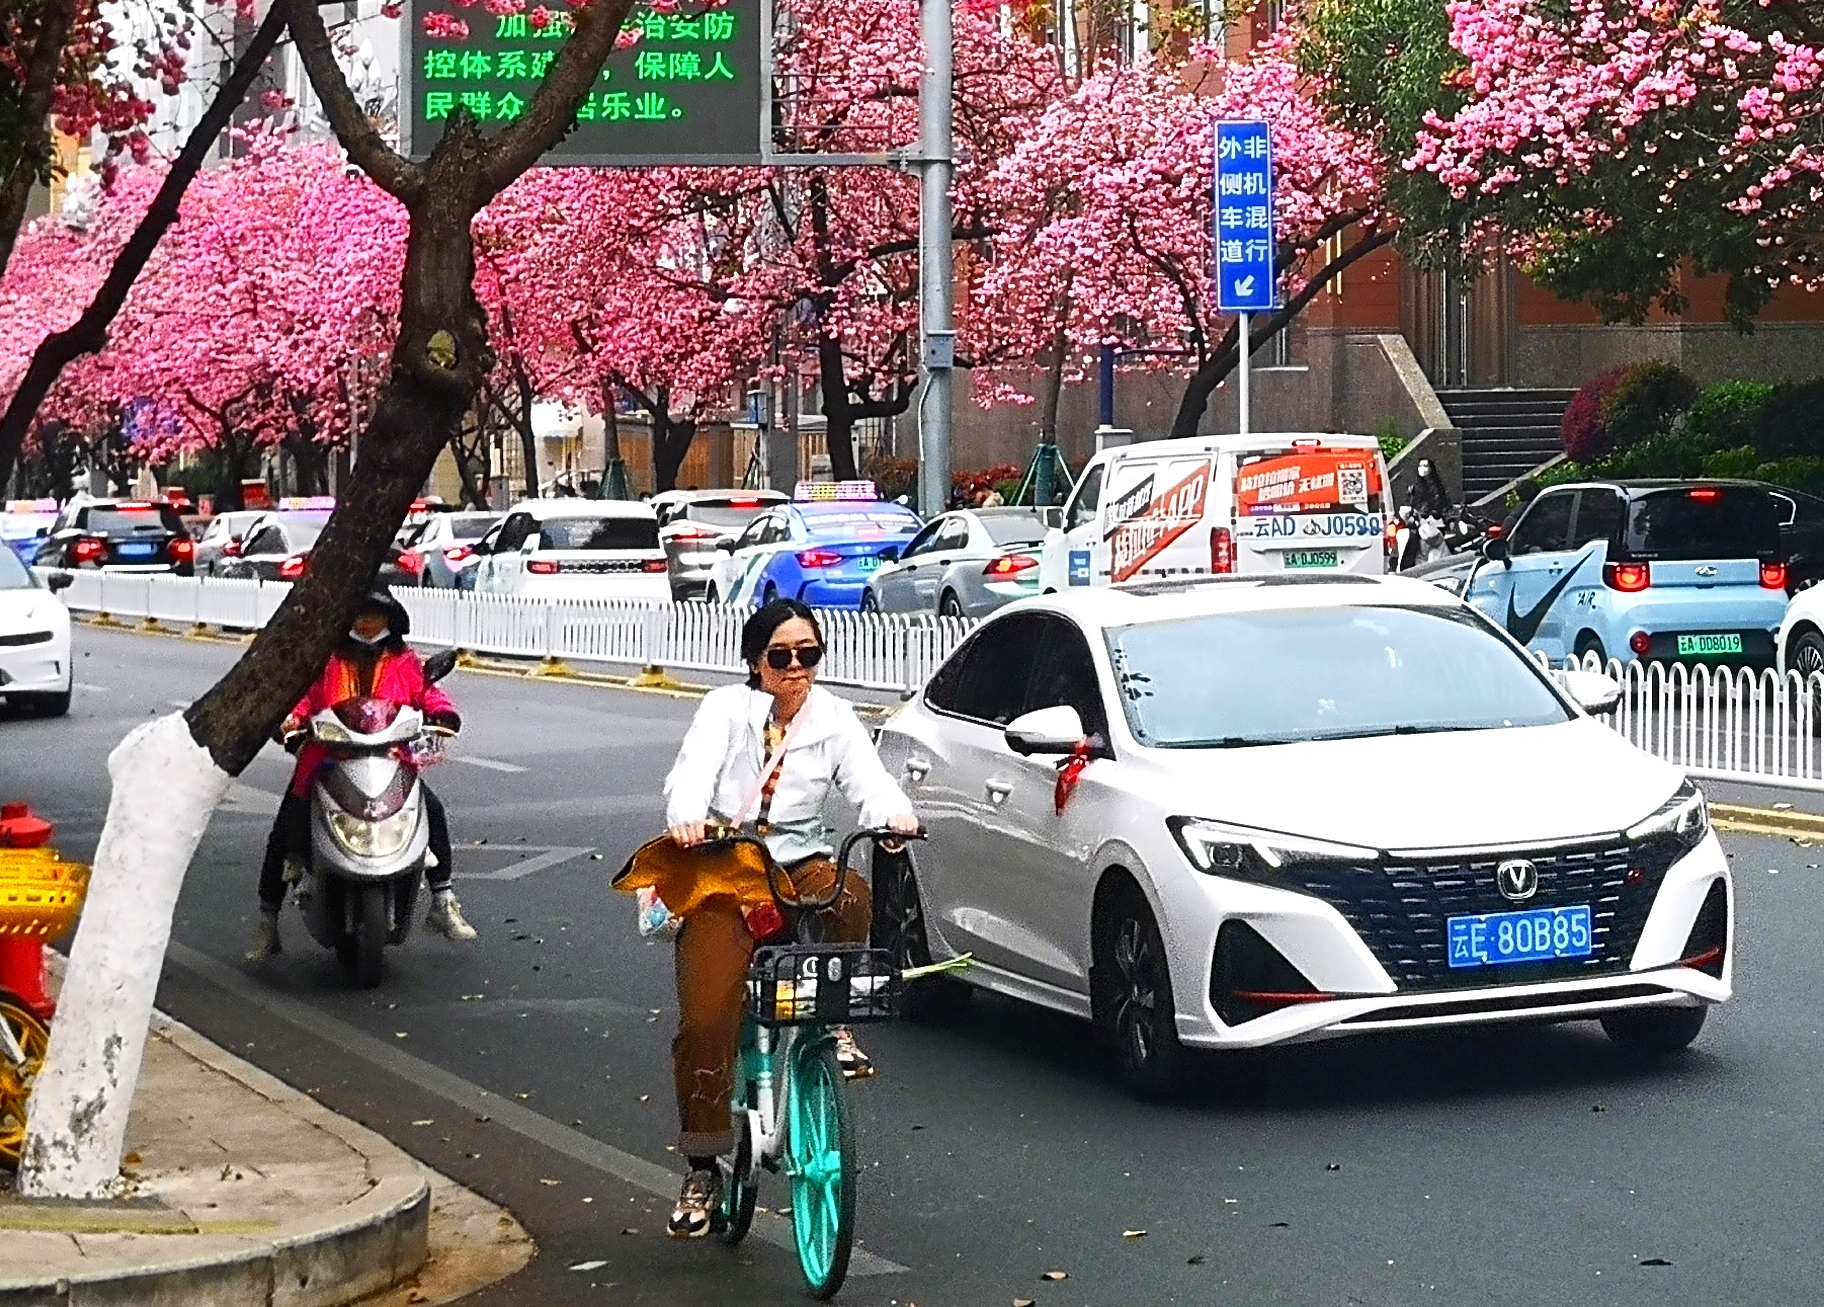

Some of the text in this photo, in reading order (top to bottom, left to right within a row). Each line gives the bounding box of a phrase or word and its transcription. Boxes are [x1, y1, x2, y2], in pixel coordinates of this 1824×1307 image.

[495, 10, 735, 41] 加强治安防
[424, 90, 688, 121] 民群众居乐业。
[1219, 135, 1244, 263] 外侧车道
[1243, 135, 1269, 263] 非机混行
[1254, 516, 1296, 537] 云AD
